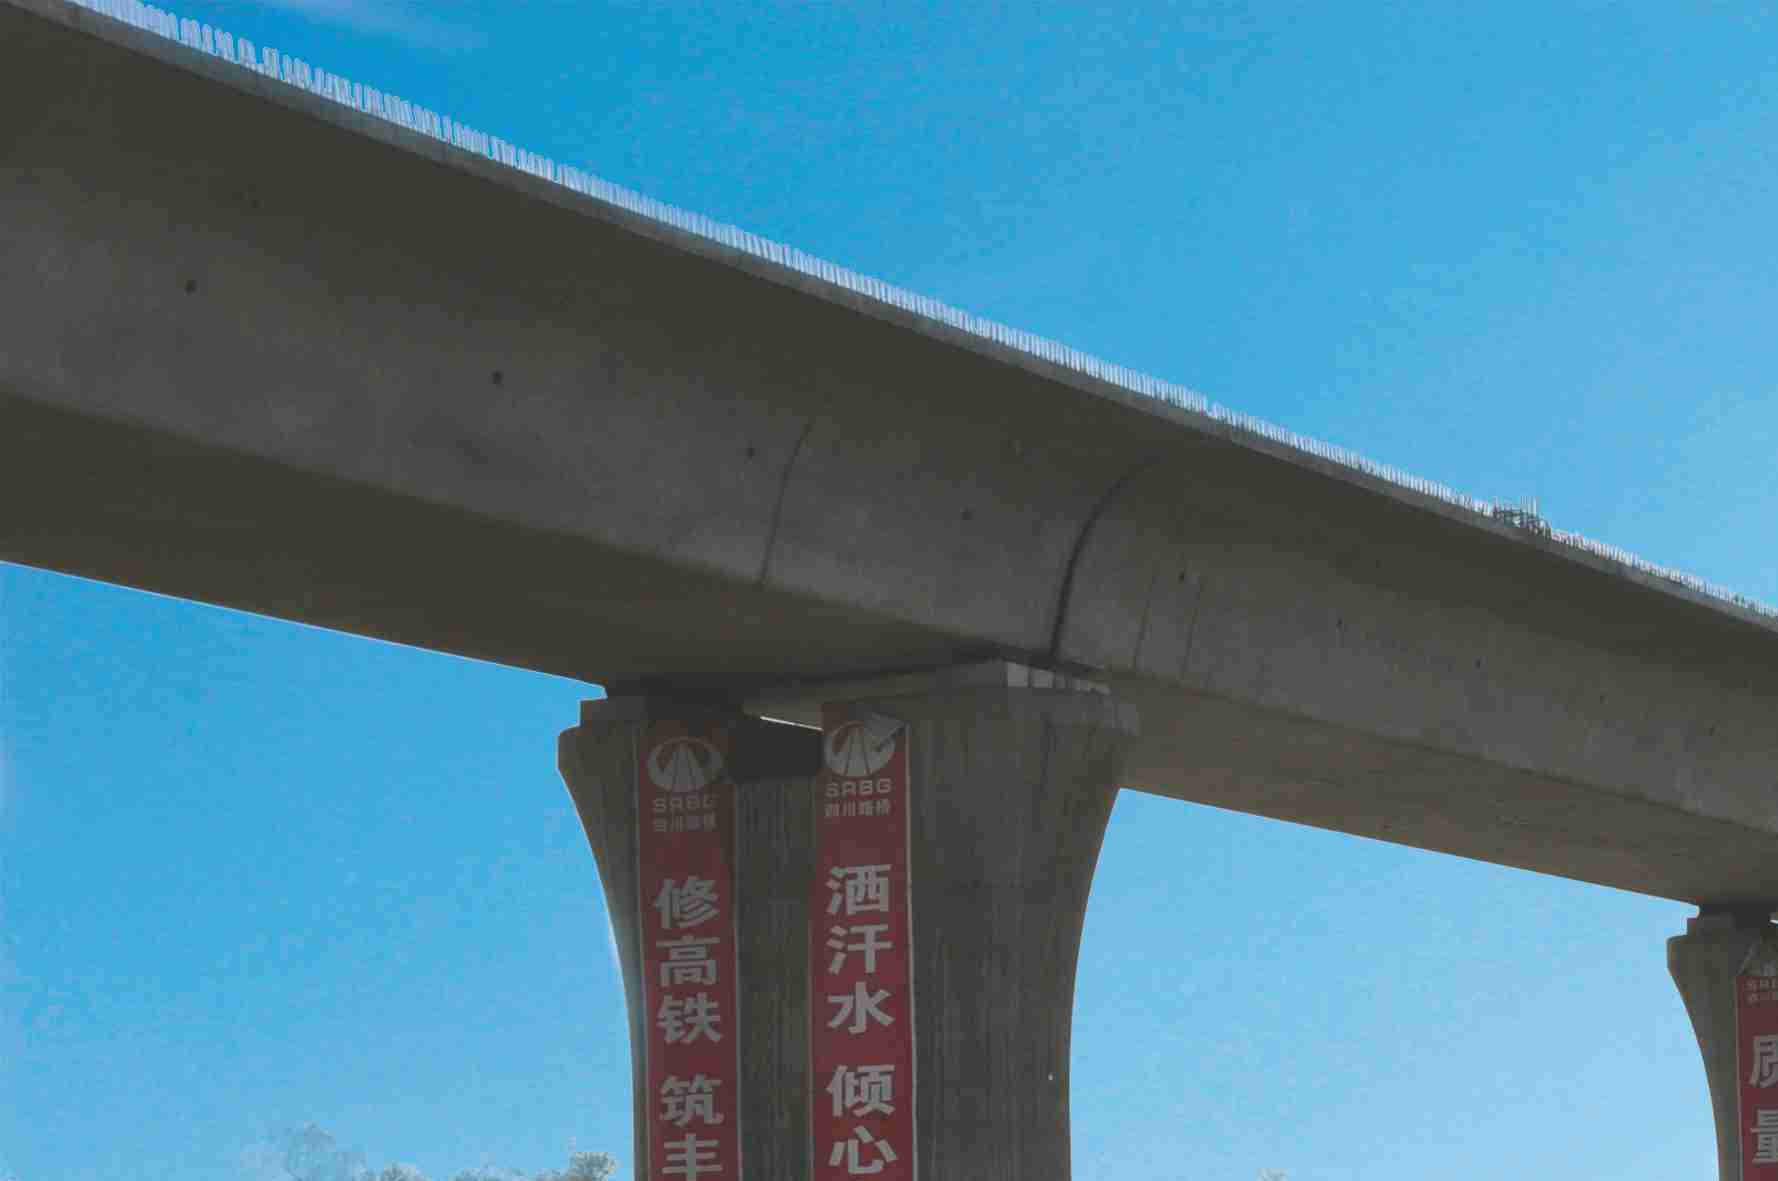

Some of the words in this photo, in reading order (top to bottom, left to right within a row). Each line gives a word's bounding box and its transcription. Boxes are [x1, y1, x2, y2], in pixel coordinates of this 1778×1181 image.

[824, 777, 892, 798] SRBG
[655, 875, 723, 1044] 修高铁
[825, 862, 896, 1035] 洒汗水
